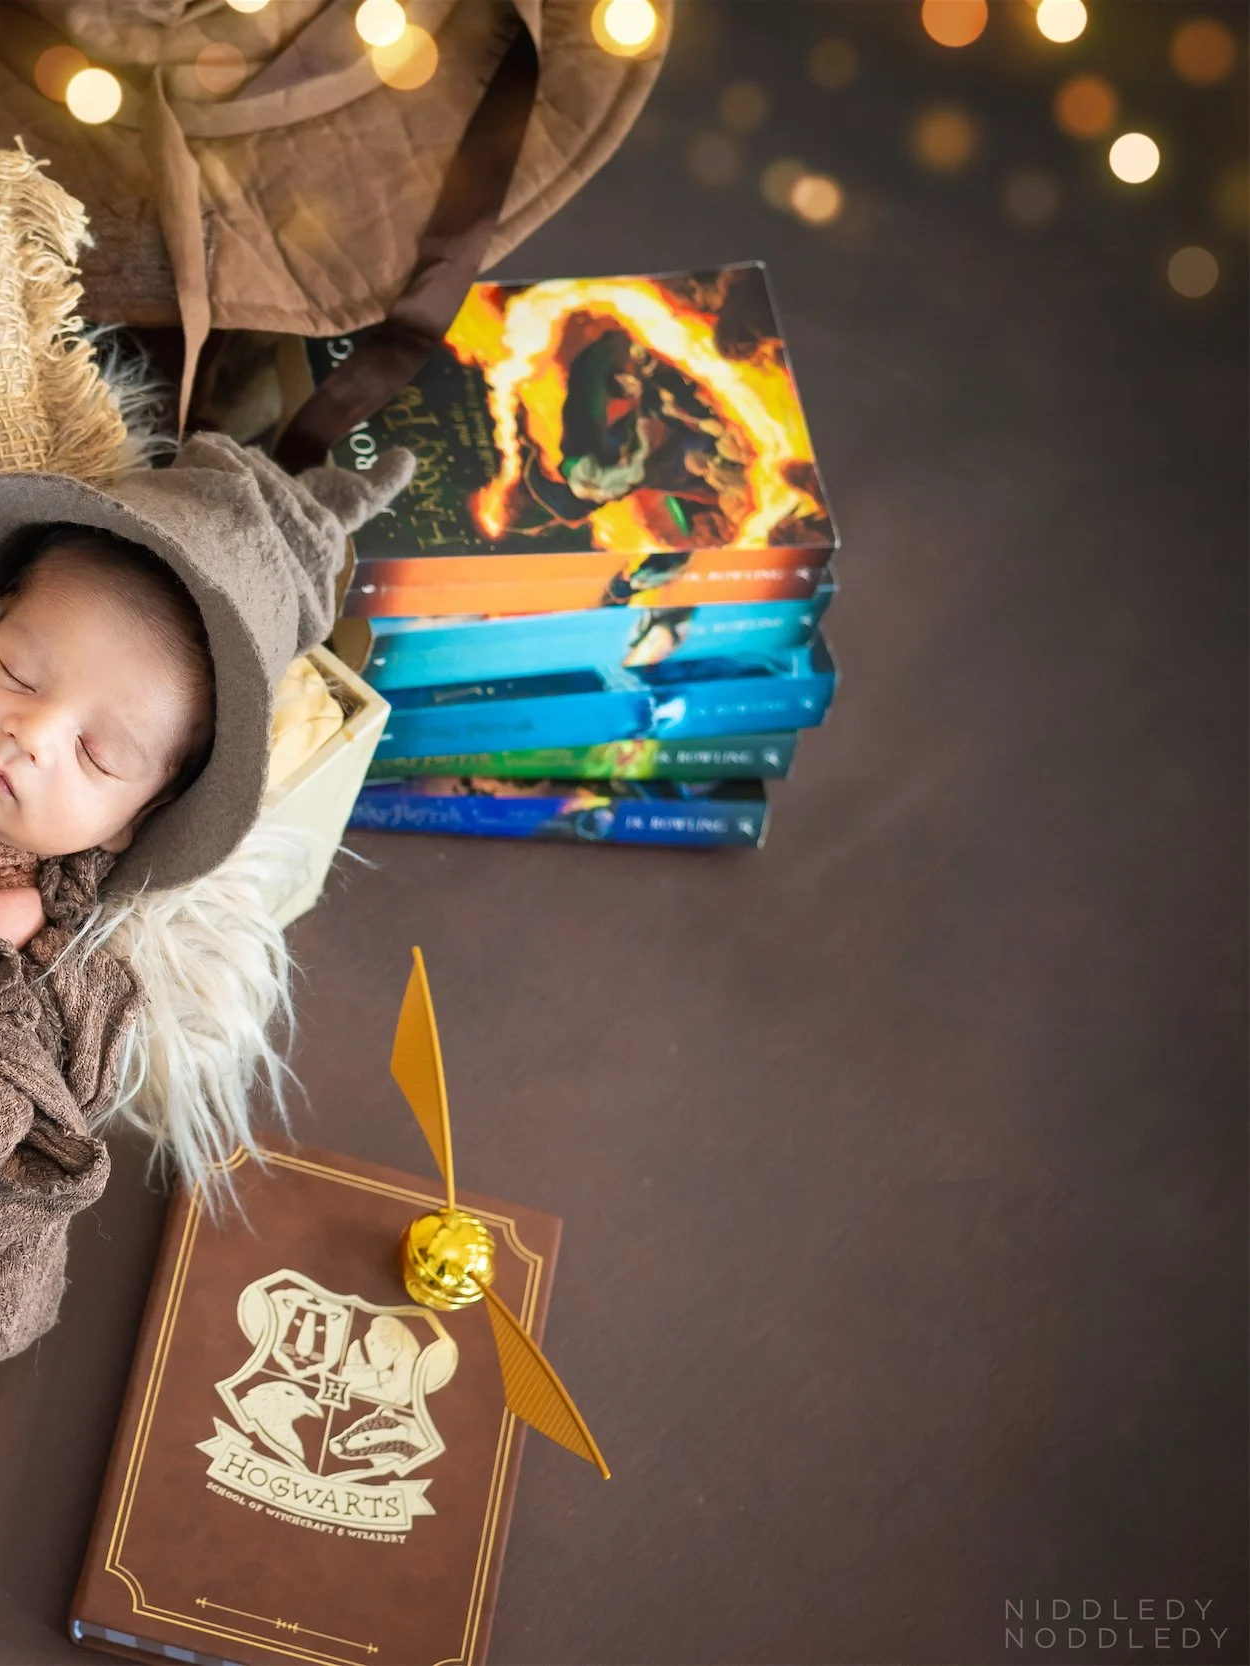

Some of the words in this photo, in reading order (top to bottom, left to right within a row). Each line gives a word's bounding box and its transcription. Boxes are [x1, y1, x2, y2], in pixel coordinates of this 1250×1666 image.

[649, 815, 729, 833] ROWLING
[205, 1480, 246, 1506] SCHOOL
[248, 1499, 264, 1513] OF
[265, 1507, 335, 1535] WITCHCRAFT
[346, 1529, 407, 1545] WIZARDRY
[219, 1452, 401, 1519] HOGWARTS
